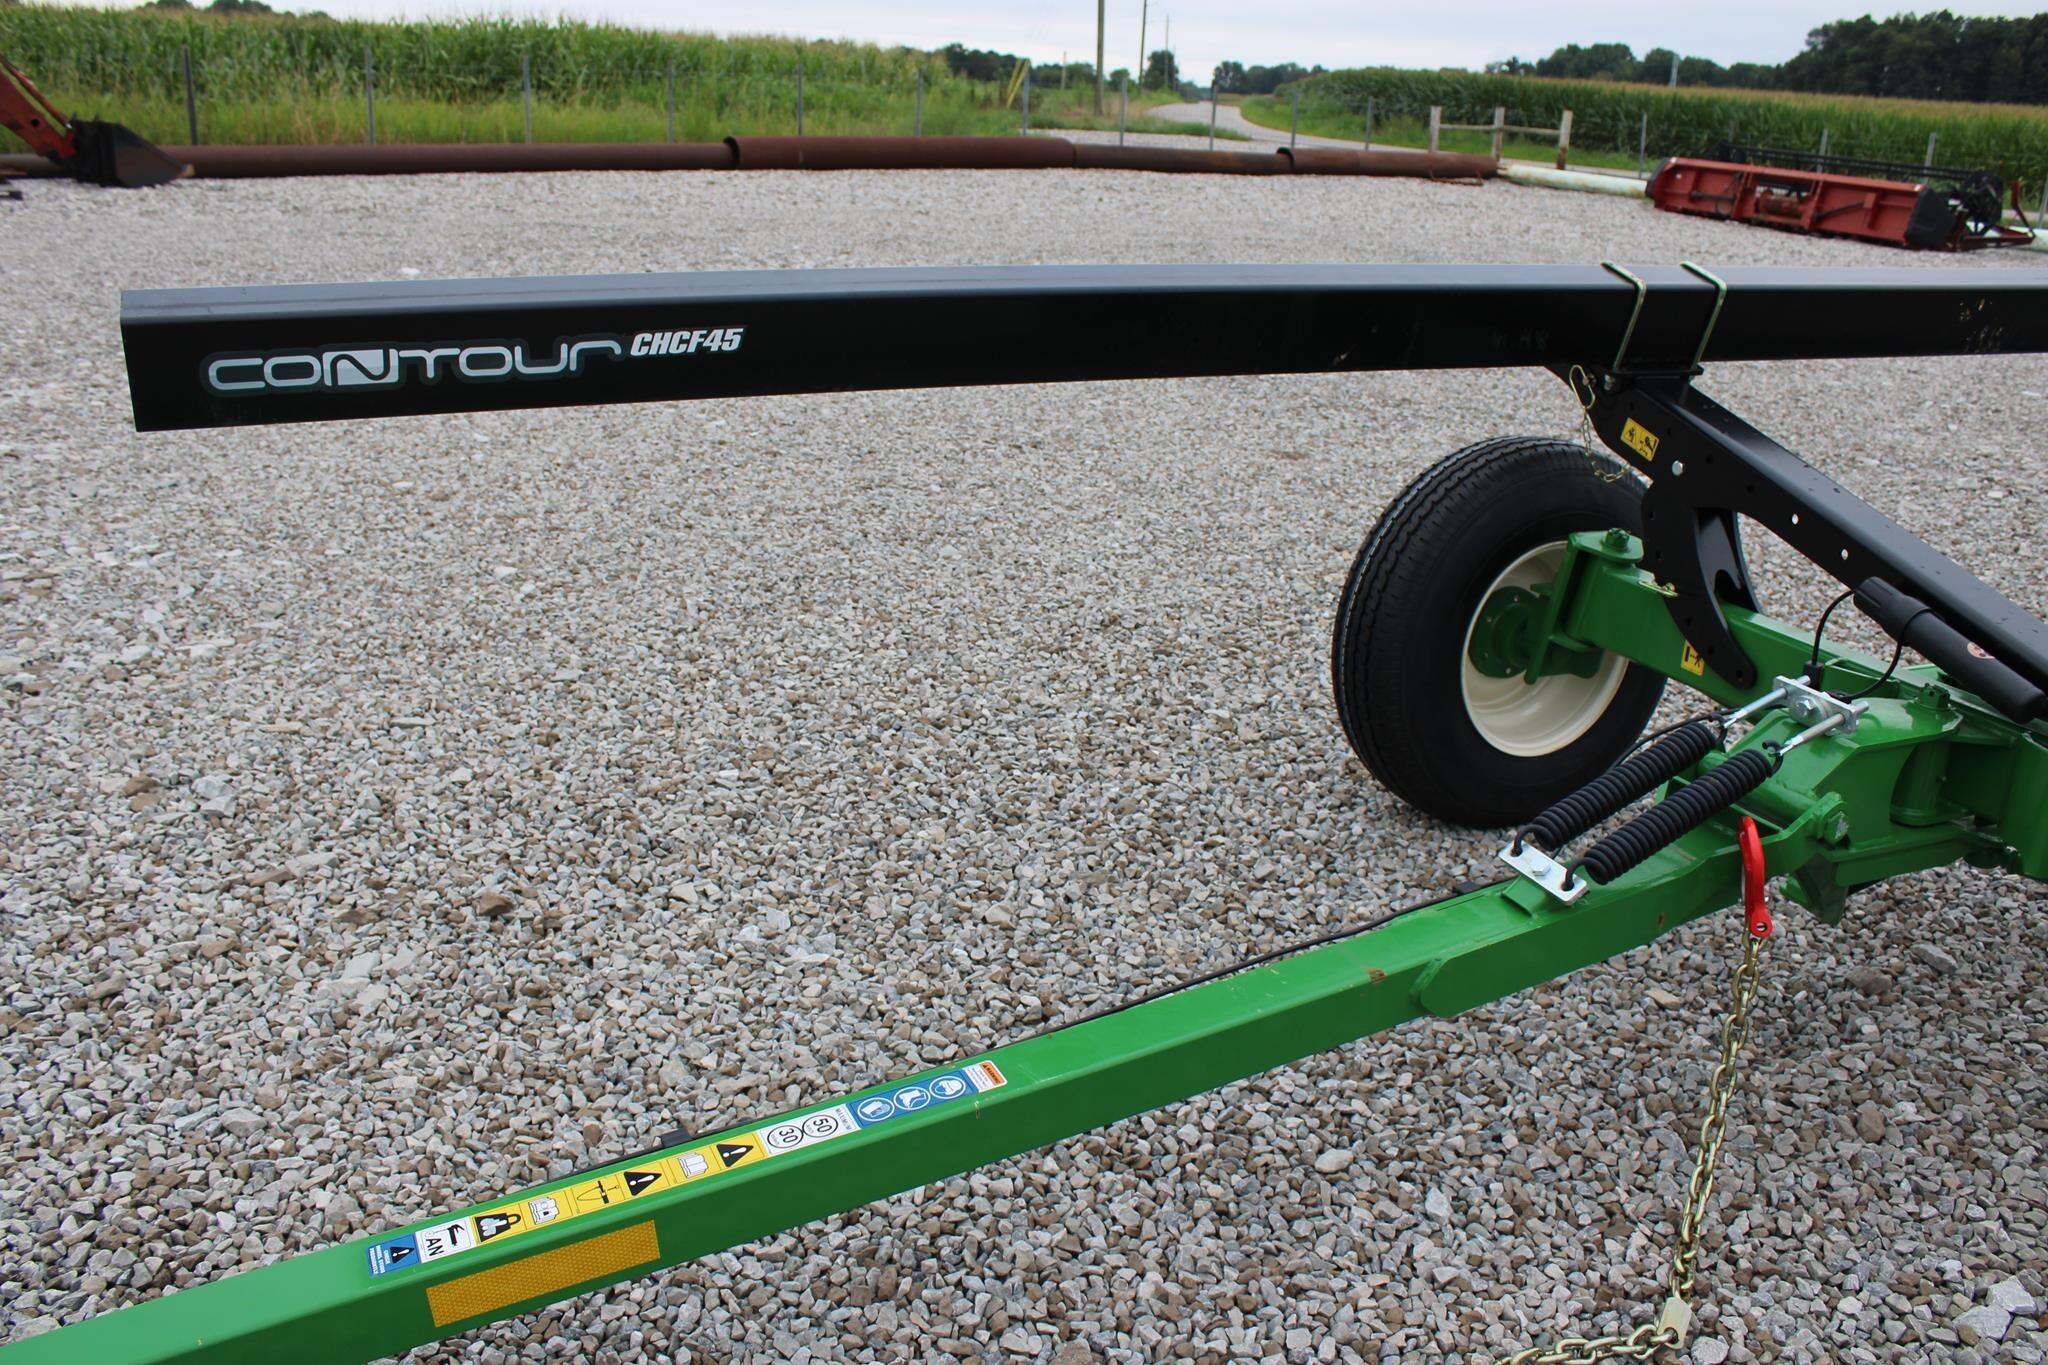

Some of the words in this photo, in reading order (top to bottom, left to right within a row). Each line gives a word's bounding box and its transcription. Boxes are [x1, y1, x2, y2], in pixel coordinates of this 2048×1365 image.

[630, 328, 744, 356] CHCF45
[813, 1118, 832, 1133] 50
[779, 1128, 798, 1143] 30
[426, 1238, 445, 1256] AN
